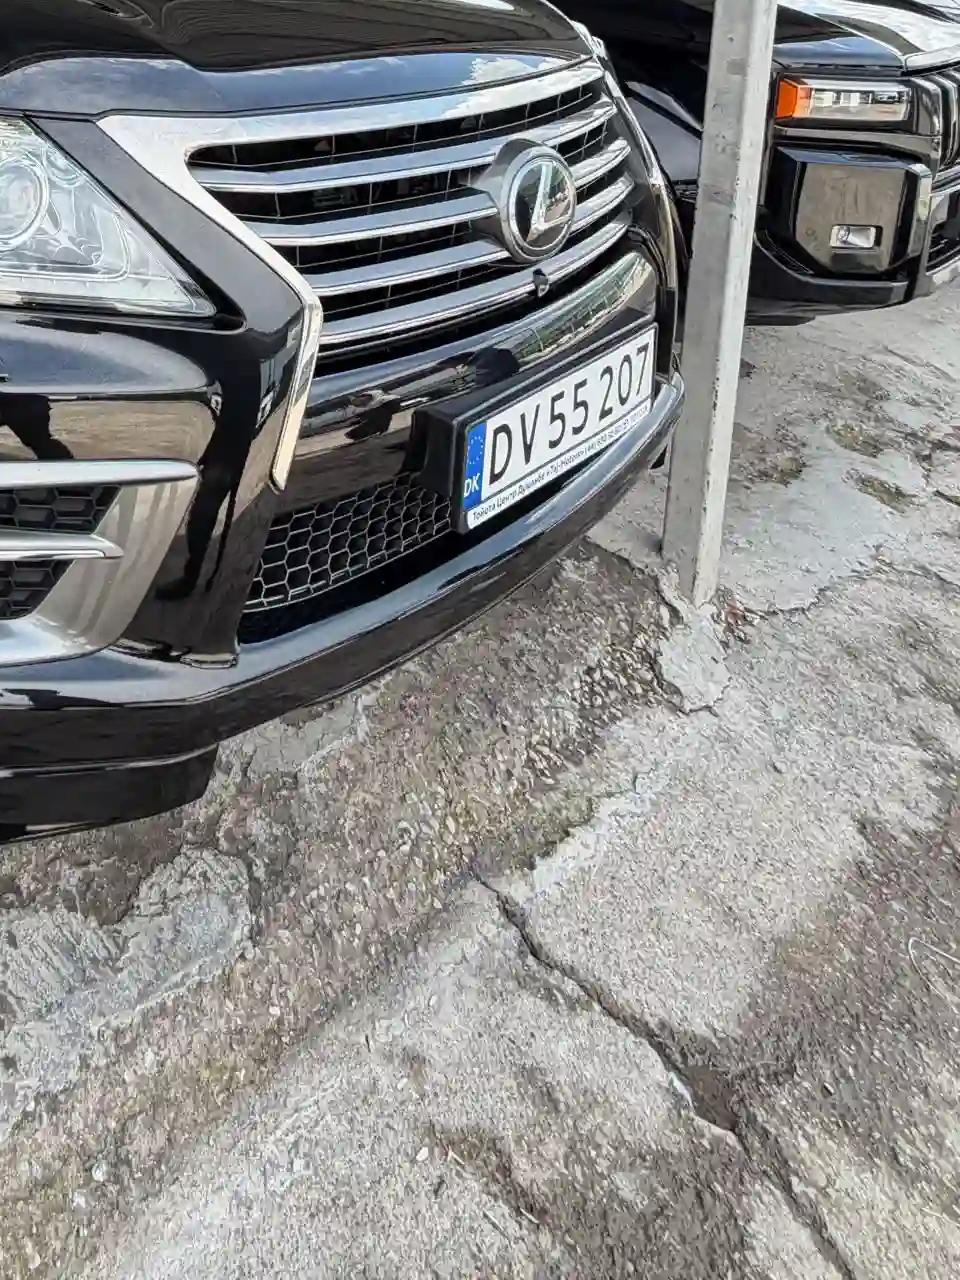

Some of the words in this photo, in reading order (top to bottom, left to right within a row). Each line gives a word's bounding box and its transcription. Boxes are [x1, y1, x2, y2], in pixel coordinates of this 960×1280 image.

[489, 403, 540, 486] DV
[548, 378, 589, 450] 55
[598, 342, 649, 422] 207
[464, 473, 480, 498] DK
